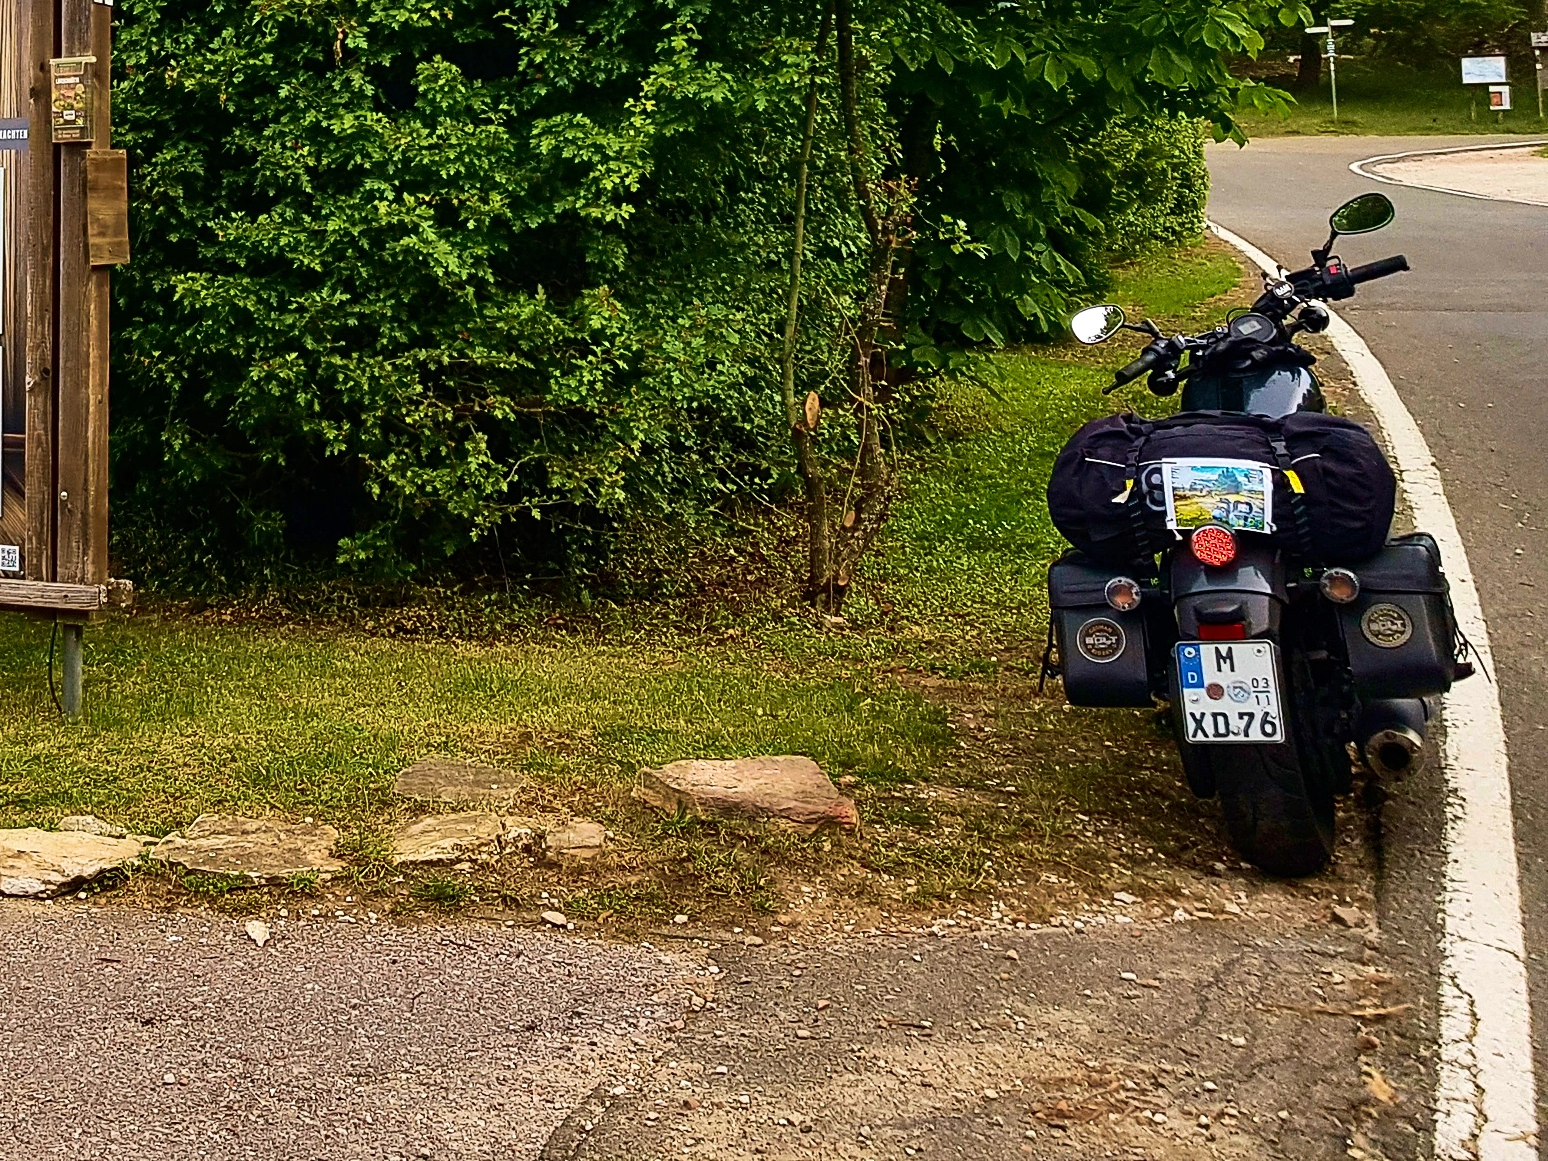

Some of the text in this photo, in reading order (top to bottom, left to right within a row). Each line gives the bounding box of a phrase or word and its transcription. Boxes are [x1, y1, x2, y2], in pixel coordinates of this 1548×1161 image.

[1214, 646, 1235, 673] M
[1187, 671, 1198, 684] D
[1251, 677, 1270, 689] 03
[1254, 694, 1271, 706] 11
